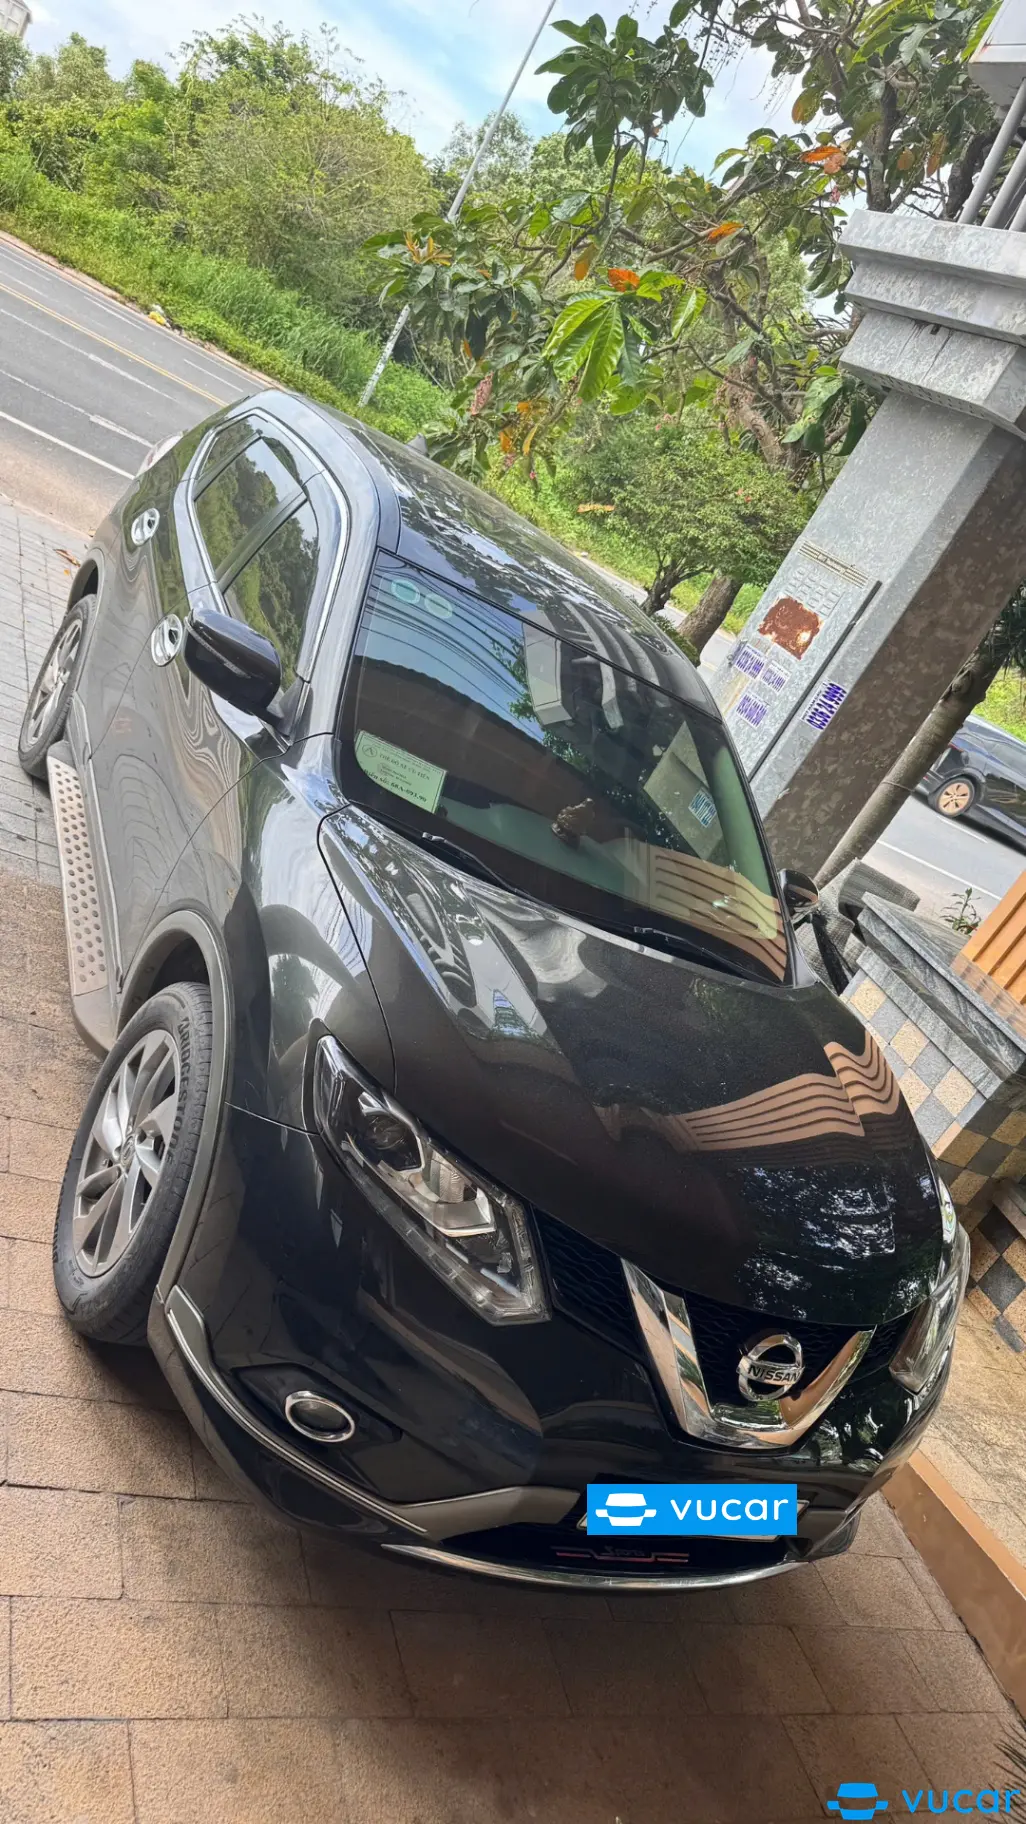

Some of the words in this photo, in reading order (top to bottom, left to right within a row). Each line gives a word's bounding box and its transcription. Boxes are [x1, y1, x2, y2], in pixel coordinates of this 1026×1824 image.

[822, 682, 847, 705] 9999
[816, 699, 837, 714] 24
[806, 708, 831, 730] 0336
[166, 1016, 191, 1166] BRIDGESTONE
[747, 1364, 799, 1383] NISSAN
